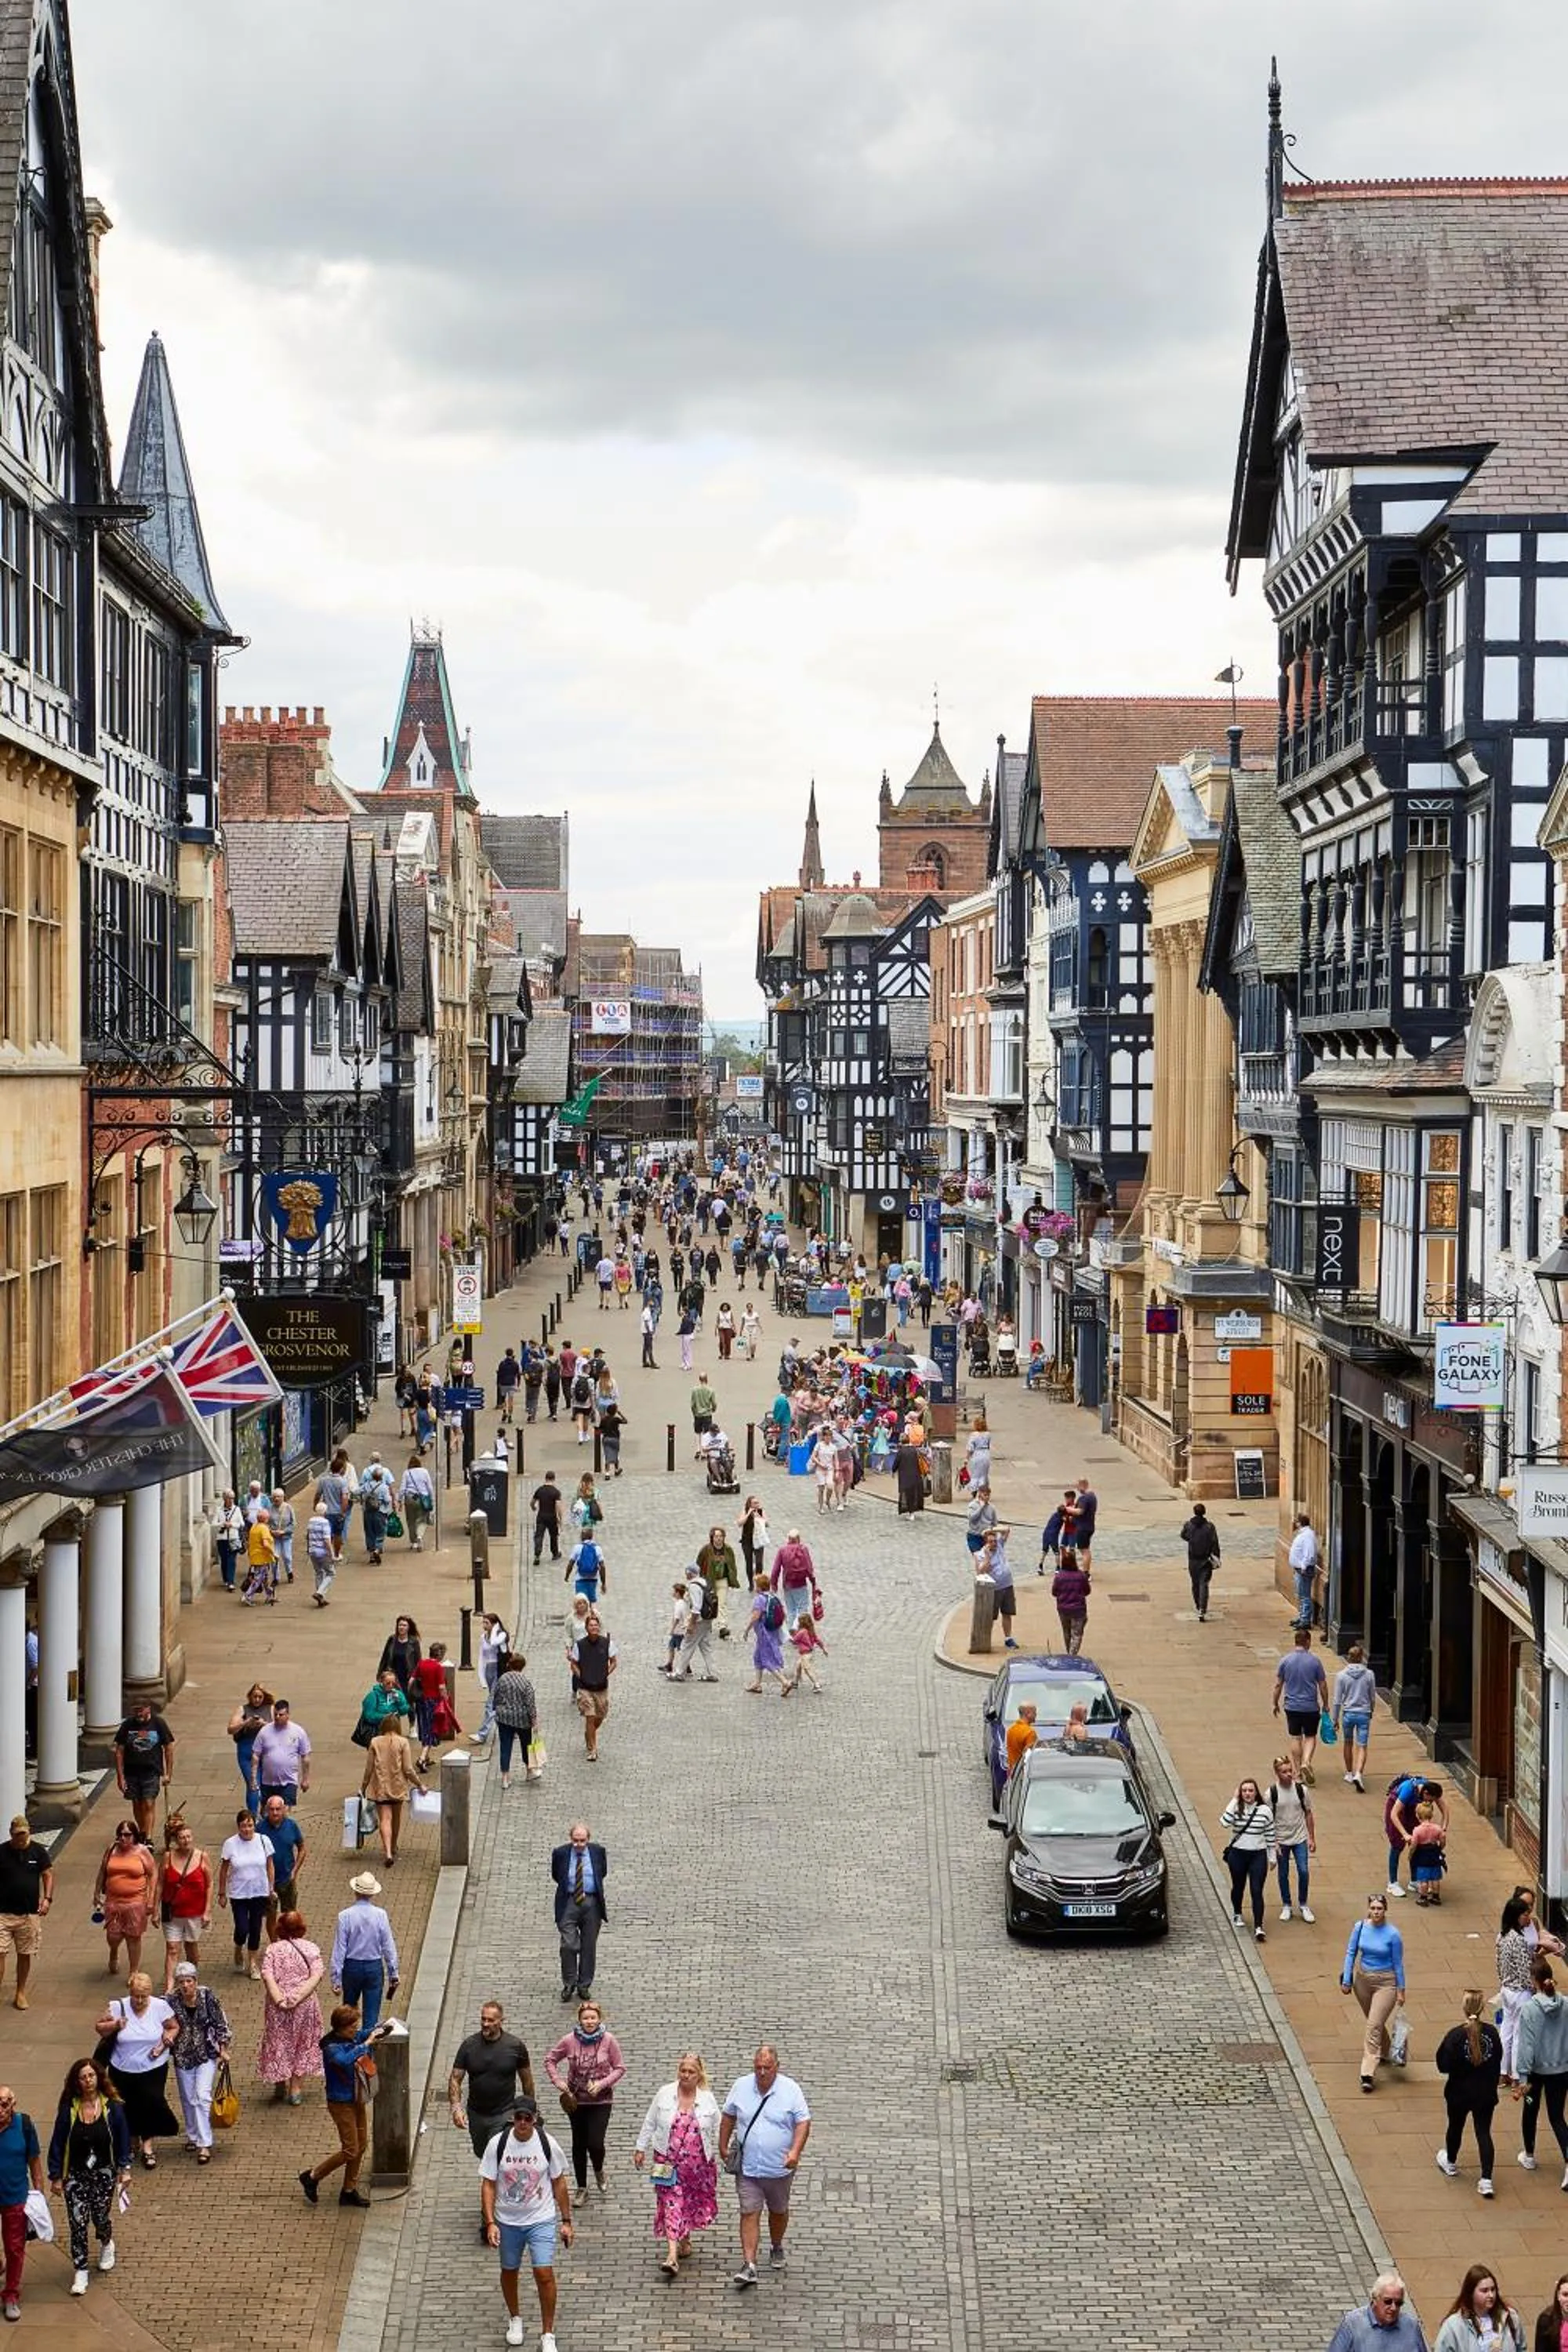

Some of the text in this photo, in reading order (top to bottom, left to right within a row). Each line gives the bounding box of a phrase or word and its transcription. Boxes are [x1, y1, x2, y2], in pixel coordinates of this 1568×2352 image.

[1323, 1215, 1343, 1282] next
[286, 1310, 320, 1323] THE
[267, 1327, 338, 1340] CHESTER
[260, 1343, 351, 1357] GROSVENOR
[1448, 1356, 1491, 1366] FONE
[1438, 1368, 1501, 1381] GALAXY
[1236, 1396, 1266, 1406] SOLE
